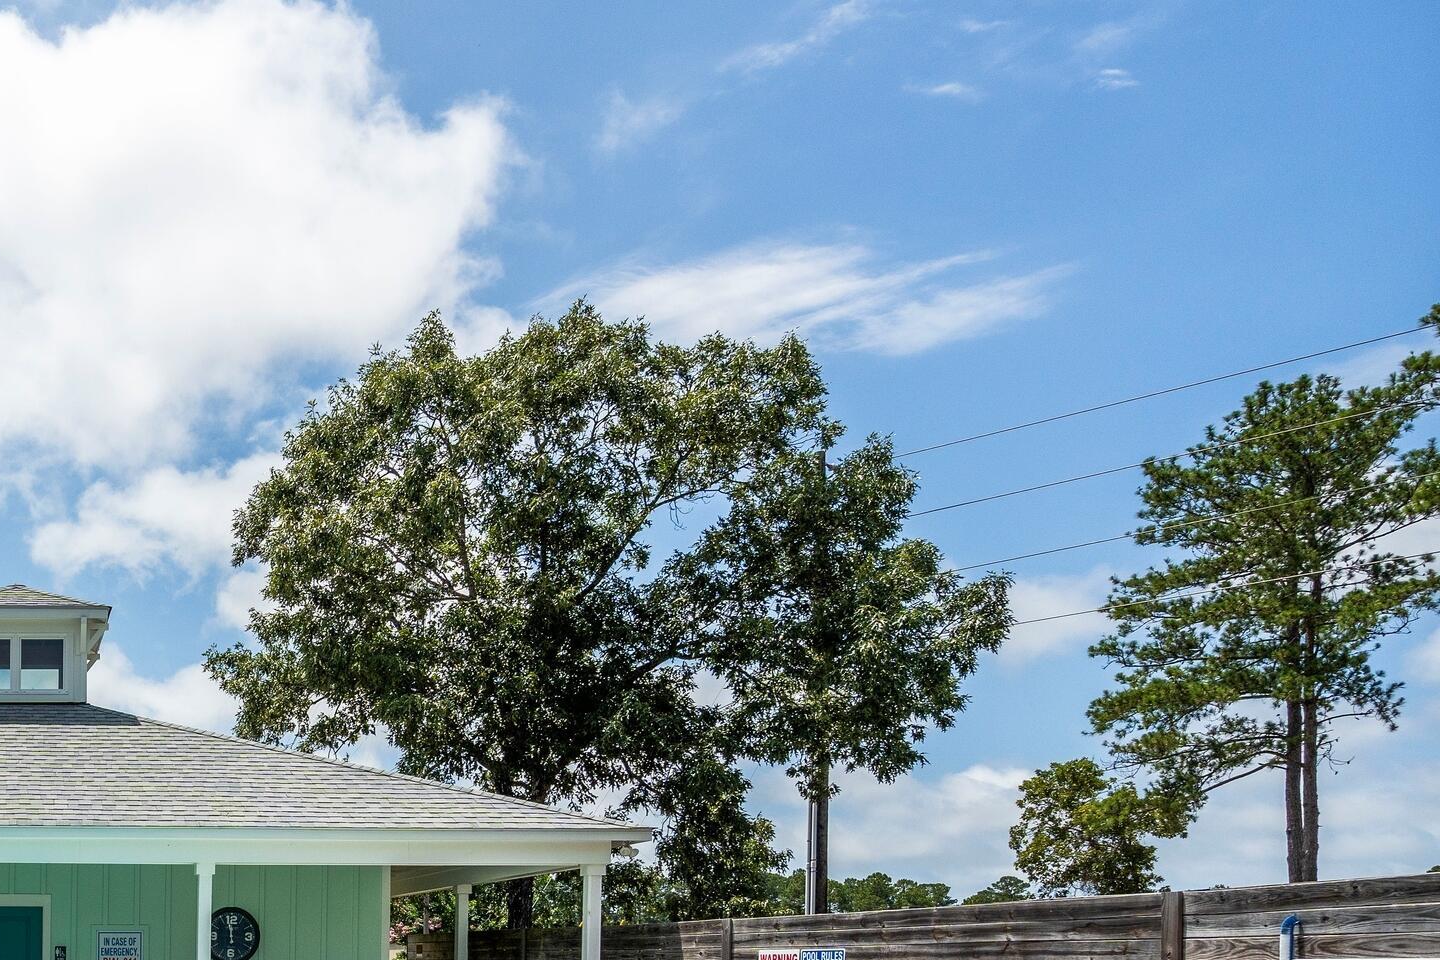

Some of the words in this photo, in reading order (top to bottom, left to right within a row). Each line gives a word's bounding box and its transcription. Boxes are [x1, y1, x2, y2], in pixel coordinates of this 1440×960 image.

[226, 916, 238, 924] 12
[244, 932, 252, 941] 3
[104, 938, 110, 946] IN
[111, 938, 127, 946] CASE
[129, 938, 136, 946] OF
[101, 948, 139, 957] EMERGENCY,
[227, 949, 234, 958] 6
[821, 951, 843, 960] RULES
